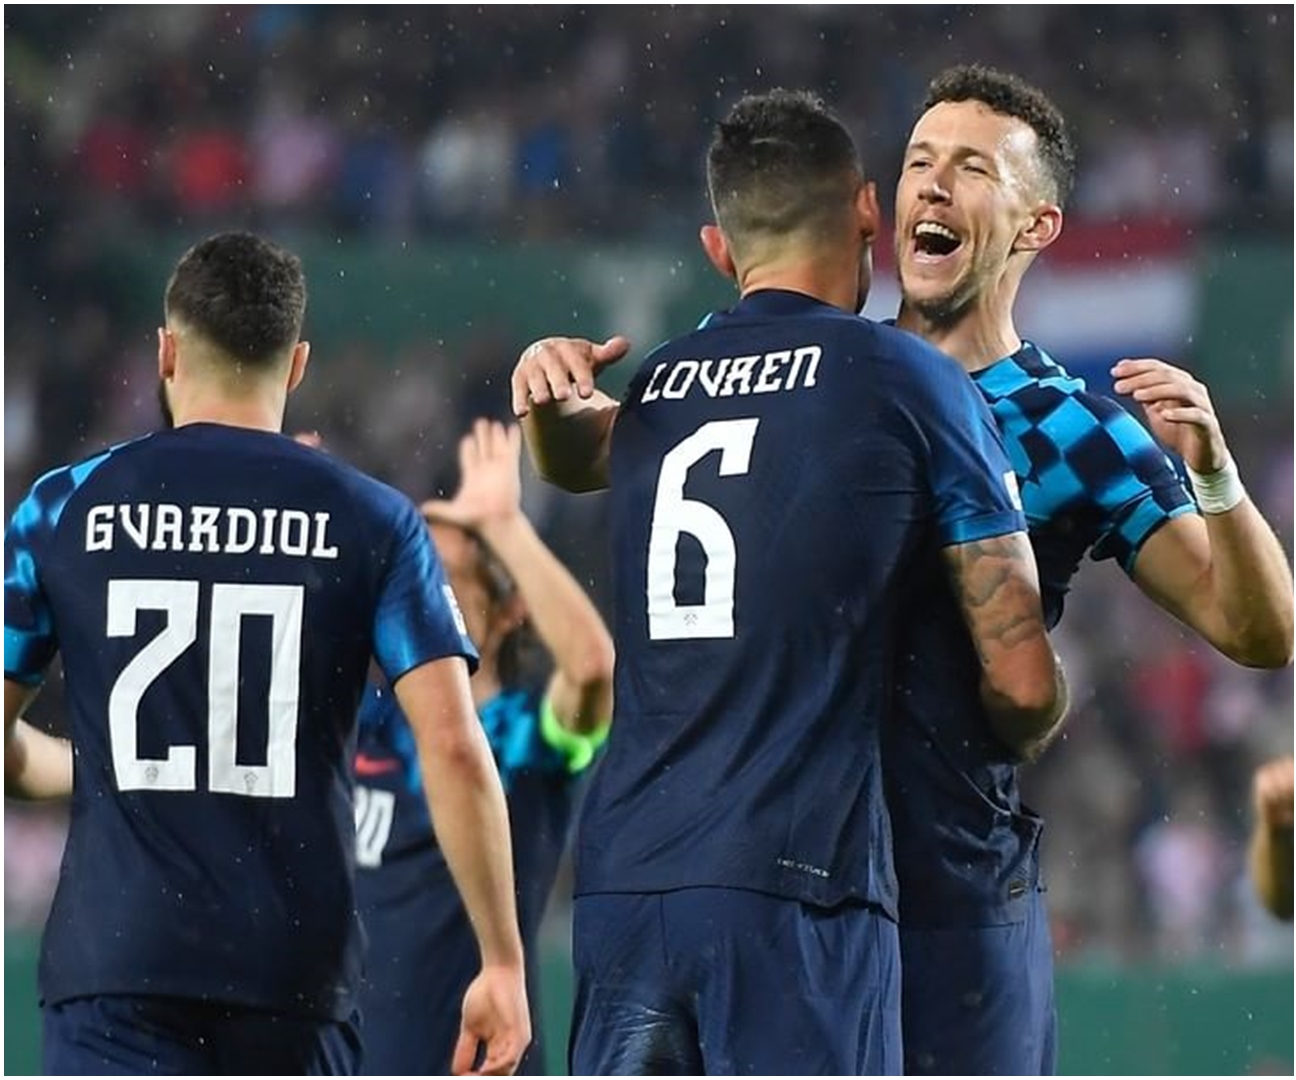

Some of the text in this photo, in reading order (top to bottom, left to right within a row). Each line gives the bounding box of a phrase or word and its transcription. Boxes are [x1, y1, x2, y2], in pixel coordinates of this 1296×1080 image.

[641, 345, 822, 403] LOVREN
[86, 503, 338, 559] GVARDIOL
[647, 417, 759, 640] 6
[107, 579, 305, 798] 20
